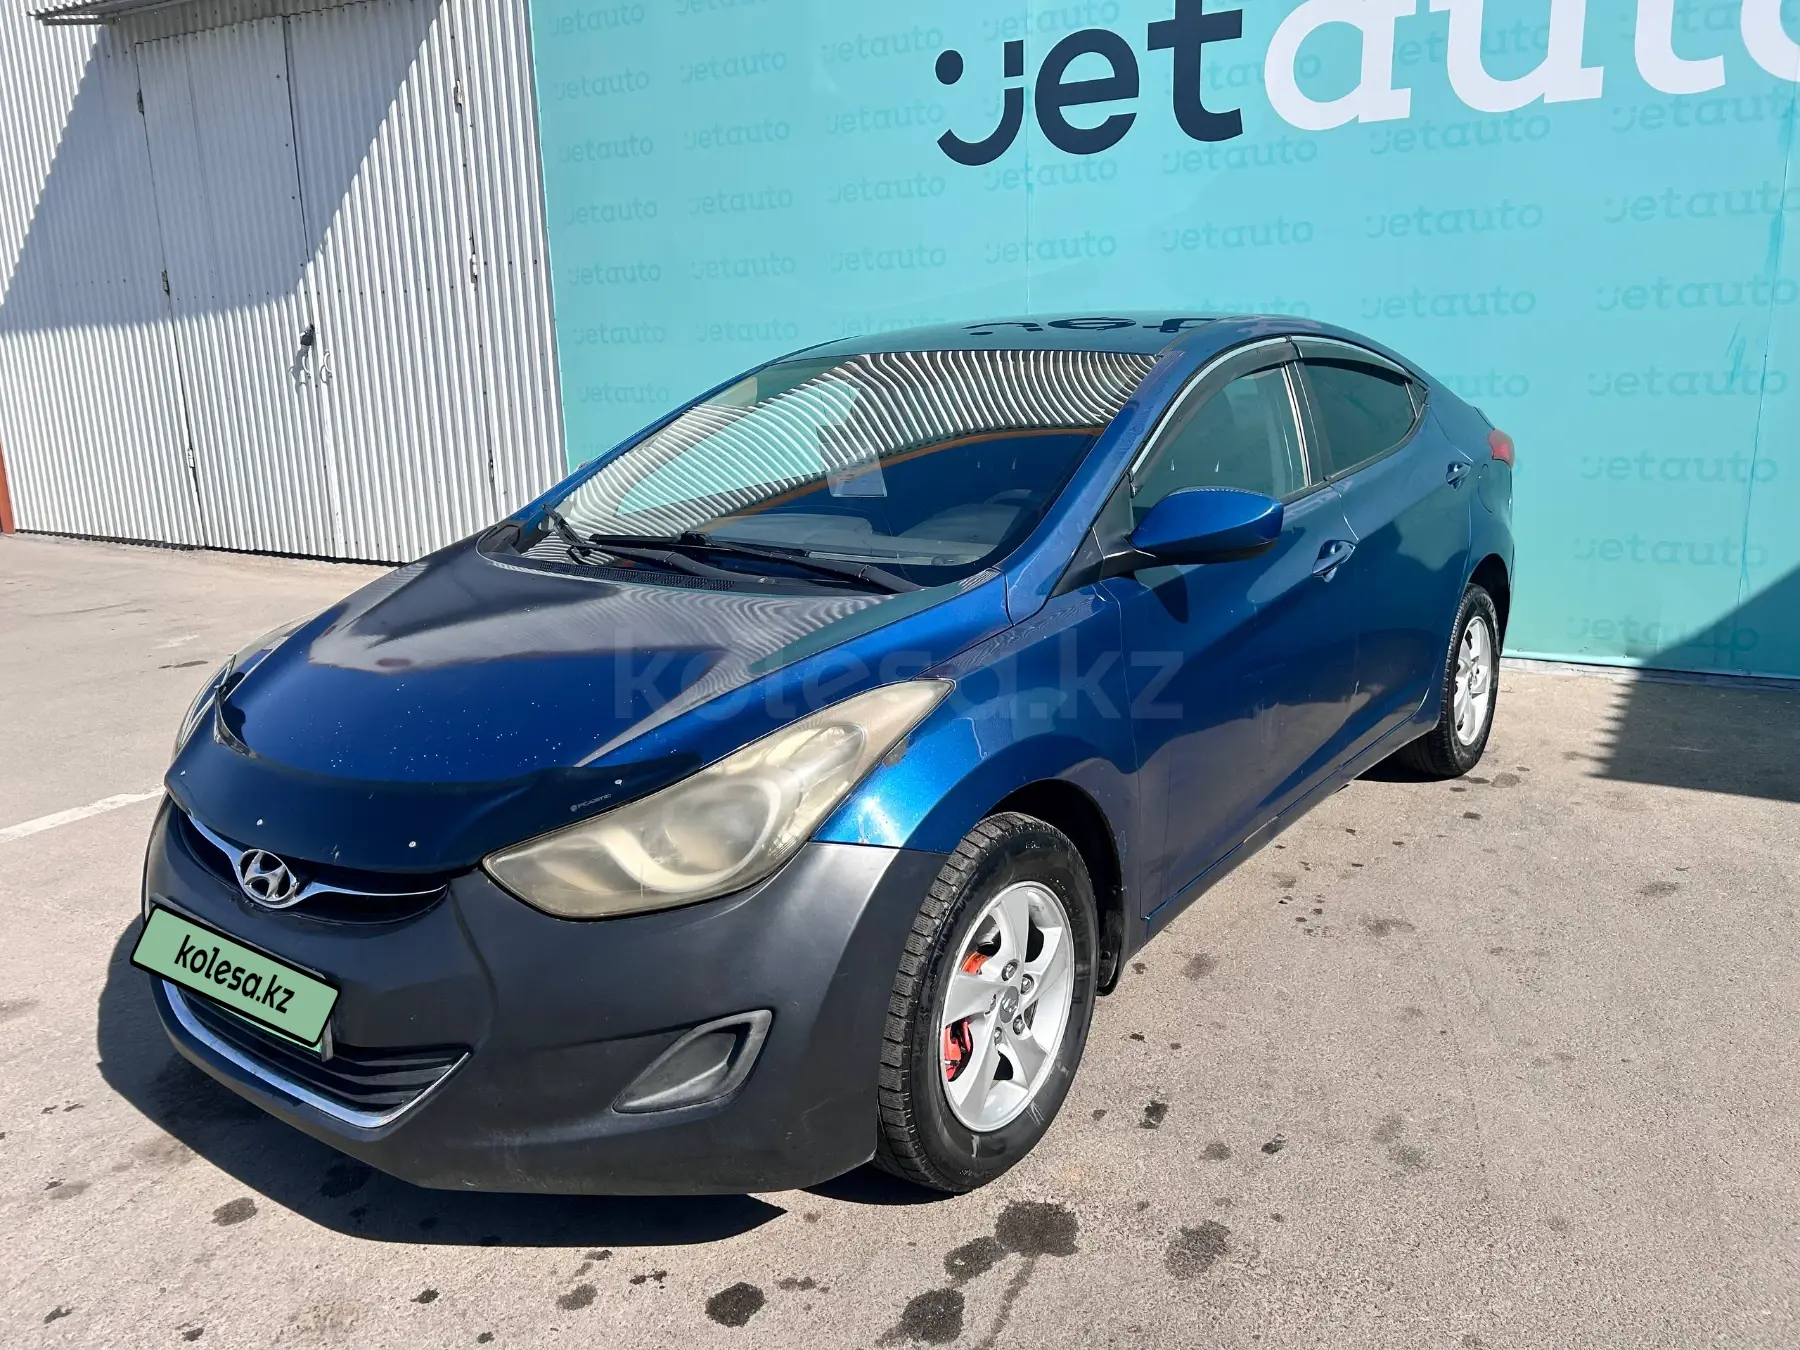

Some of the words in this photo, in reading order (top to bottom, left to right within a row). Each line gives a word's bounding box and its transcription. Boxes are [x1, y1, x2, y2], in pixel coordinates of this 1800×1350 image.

[821, 25, 944, 66] jetauto
[680, 47, 788, 85] jetauto
[555, 68, 649, 101] jetauto
[825, 98, 944, 135] jetauto
[559, 133, 654, 164] jetauto
[684, 117, 791, 151] jetauto
[1369, 113, 1551, 155] jetauto
[1161, 133, 1318, 175] jetauto
[688, 186, 794, 216] jetauto
[827, 171, 946, 205] jetauto
[564, 197, 658, 226] jetauto
[1364, 200, 1544, 239] jetauto
[985, 230, 1117, 265] jetauto
[1160, 215, 1314, 252] jetauto
[567, 256, 661, 286] jetauto
[829, 242, 947, 273] jetauto
[1361, 285, 1538, 319] jetauto
[1588, 365, 1789, 398] jetauto
[1581, 451, 1779, 483] jetauto
